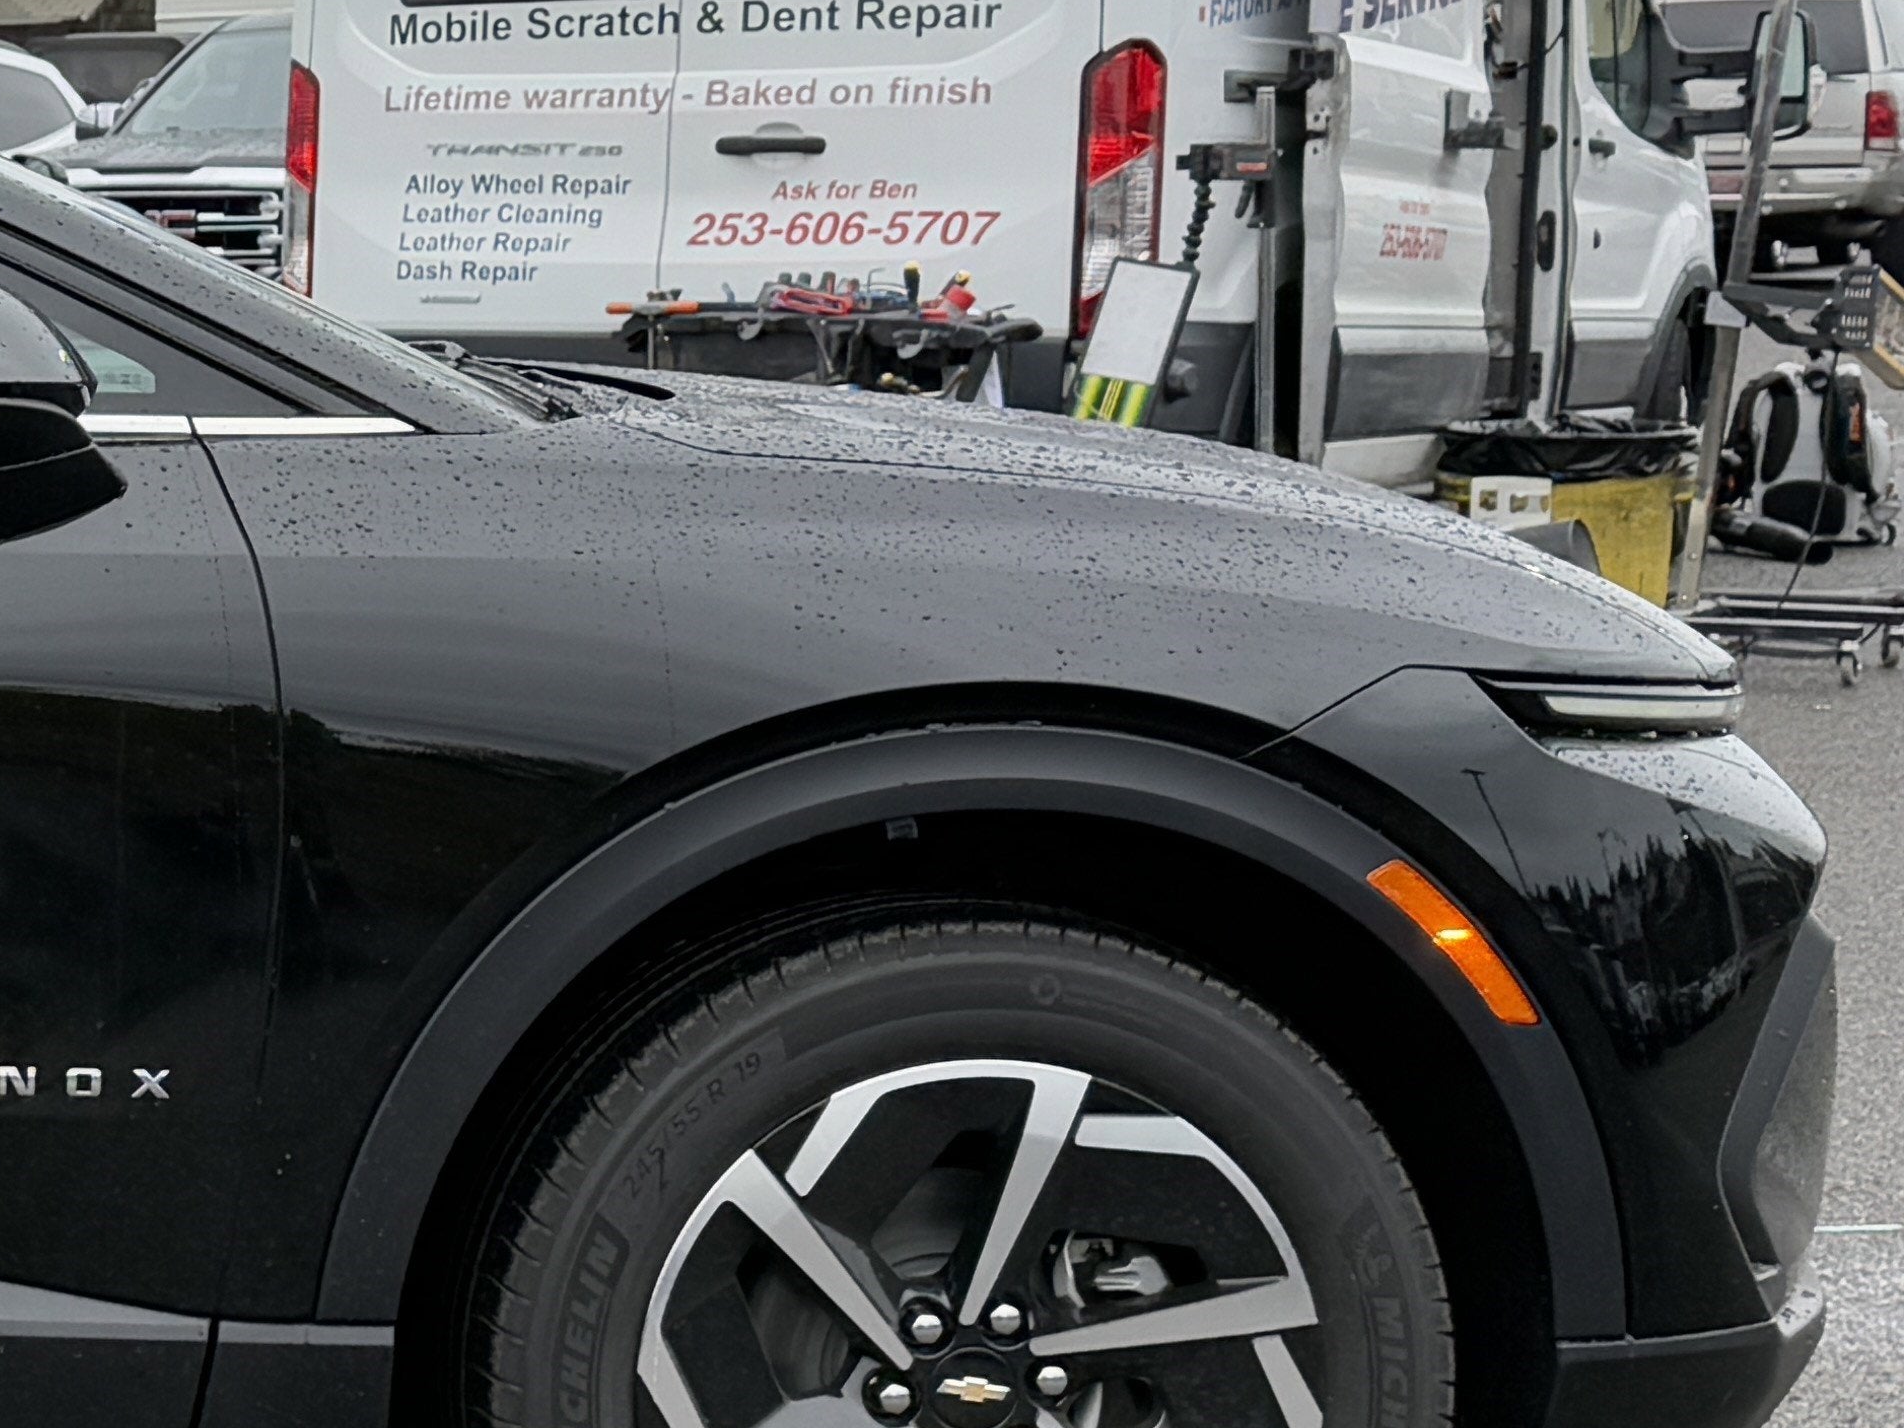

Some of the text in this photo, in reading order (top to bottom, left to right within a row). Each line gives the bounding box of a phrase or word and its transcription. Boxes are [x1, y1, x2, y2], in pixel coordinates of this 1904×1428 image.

[389, 10, 512, 46] Mobile
[527, 2, 680, 40] Scratch
[696, 0, 725, 34] &
[742, 0, 840, 32] Dent
[385, 84, 511, 112] Lifetime
[523, 83, 672, 115] warranty
[705, 78, 818, 106] Baked
[829, 83, 874, 105] on
[889, 76, 992, 105] finish
[405, 173, 632, 199] Alloy Wheel Repair
[771, 179, 918, 200] Ask for Ben
[402, 203, 603, 229] Leather Cleaning
[686, 209, 1002, 247] 253-606-5707
[398, 232, 572, 256] Leather Repair
[396, 260, 539, 285] Dash Repair
[698, 1073, 733, 1107] R
[728, 1047, 768, 1084] 19
